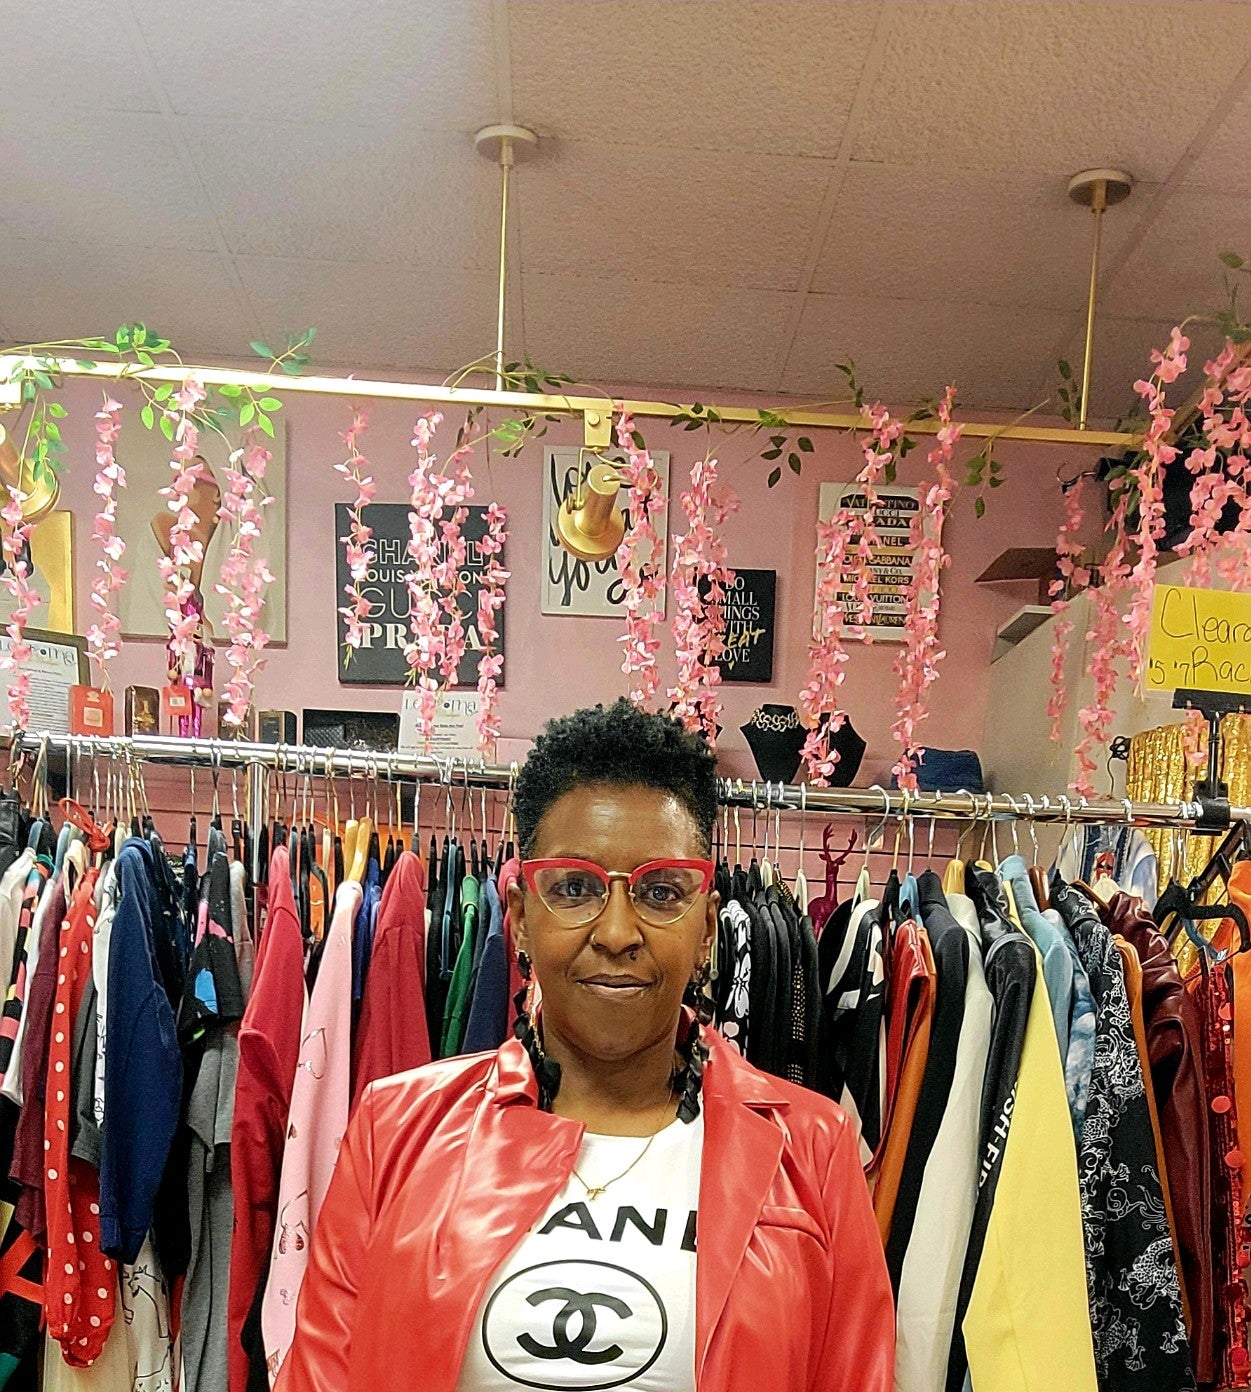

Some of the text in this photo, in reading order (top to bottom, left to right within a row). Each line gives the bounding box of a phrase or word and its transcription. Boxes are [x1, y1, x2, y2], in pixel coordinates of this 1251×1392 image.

[876, 517, 907, 527] ADA
[885, 576, 910, 585] KORS
[720, 591, 758, 606] MALL
[360, 623, 486, 651] PRA
